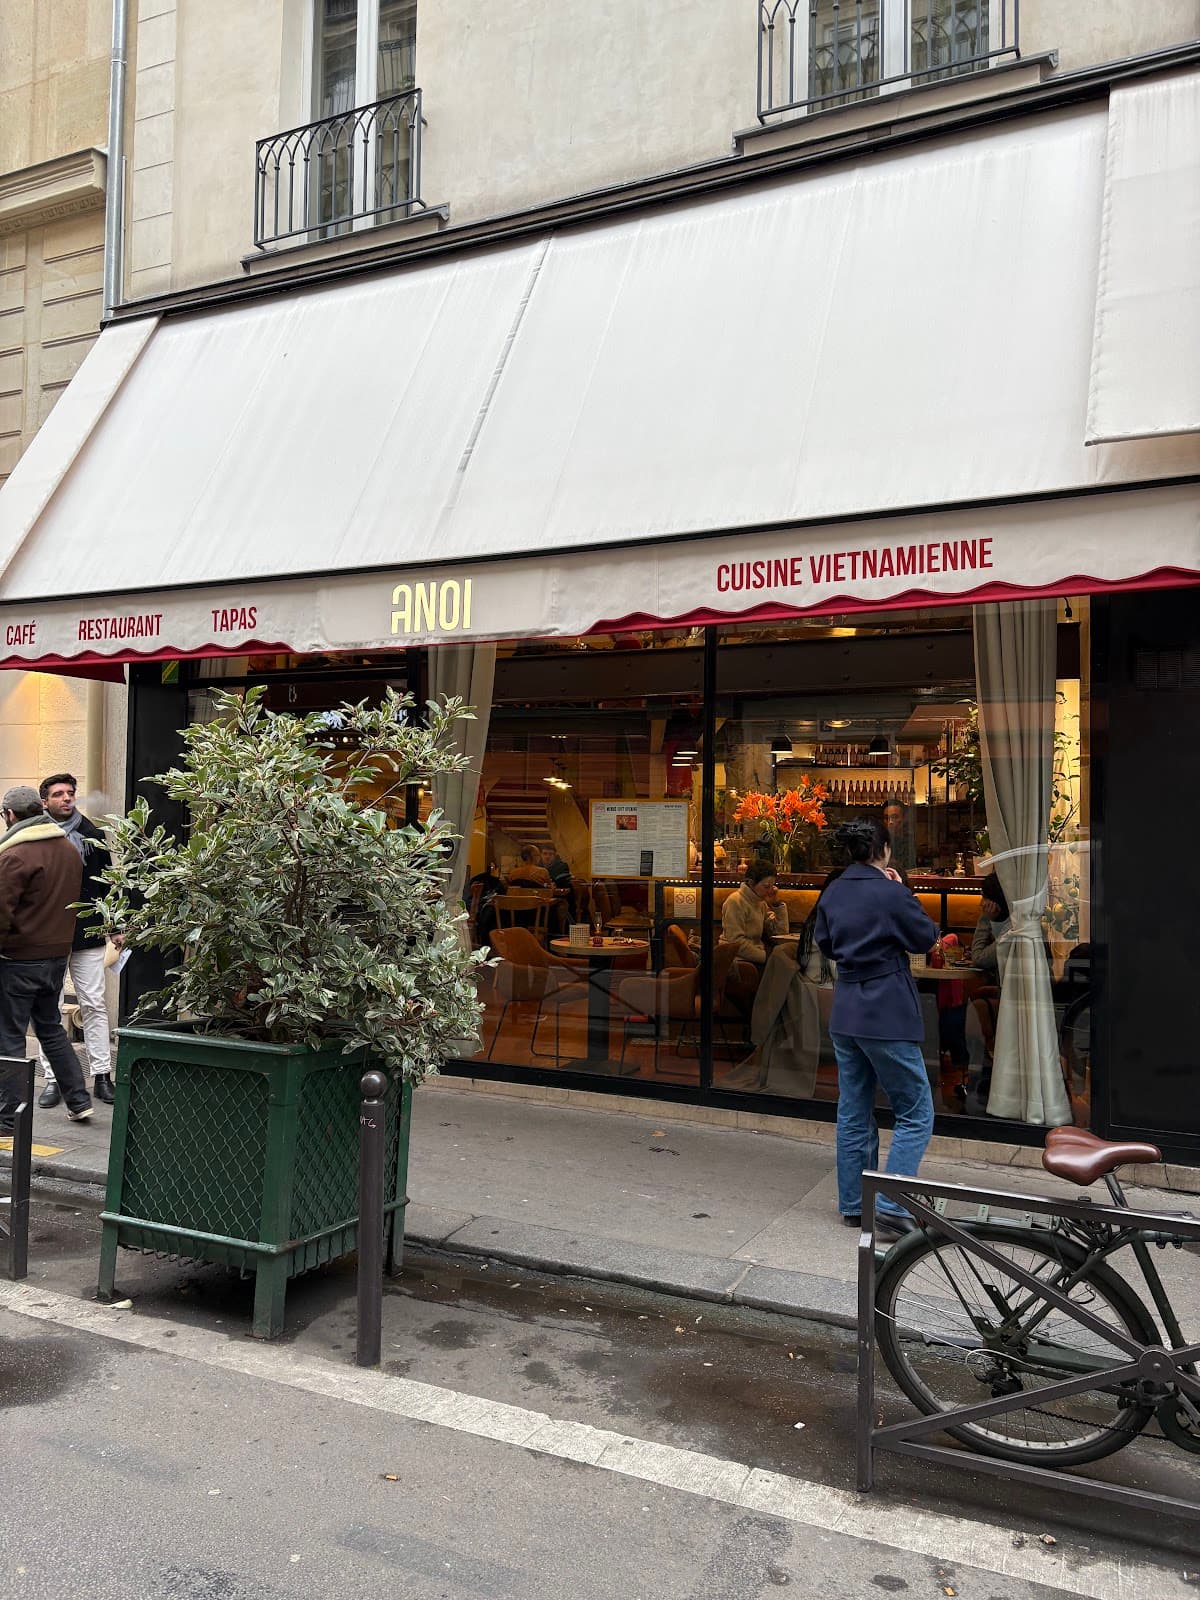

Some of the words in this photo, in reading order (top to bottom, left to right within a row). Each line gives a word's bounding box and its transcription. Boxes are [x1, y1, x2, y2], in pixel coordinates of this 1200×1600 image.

[716, 557, 803, 593] CUISINE
[809, 537, 994, 583] VIETNAMIENNE
[212, 607, 258, 632] TAPAS
[390, 577, 474, 635] ANOI
[5, 619, 36, 646] CAFÉ
[78, 613, 163, 641] RESTAURANT
